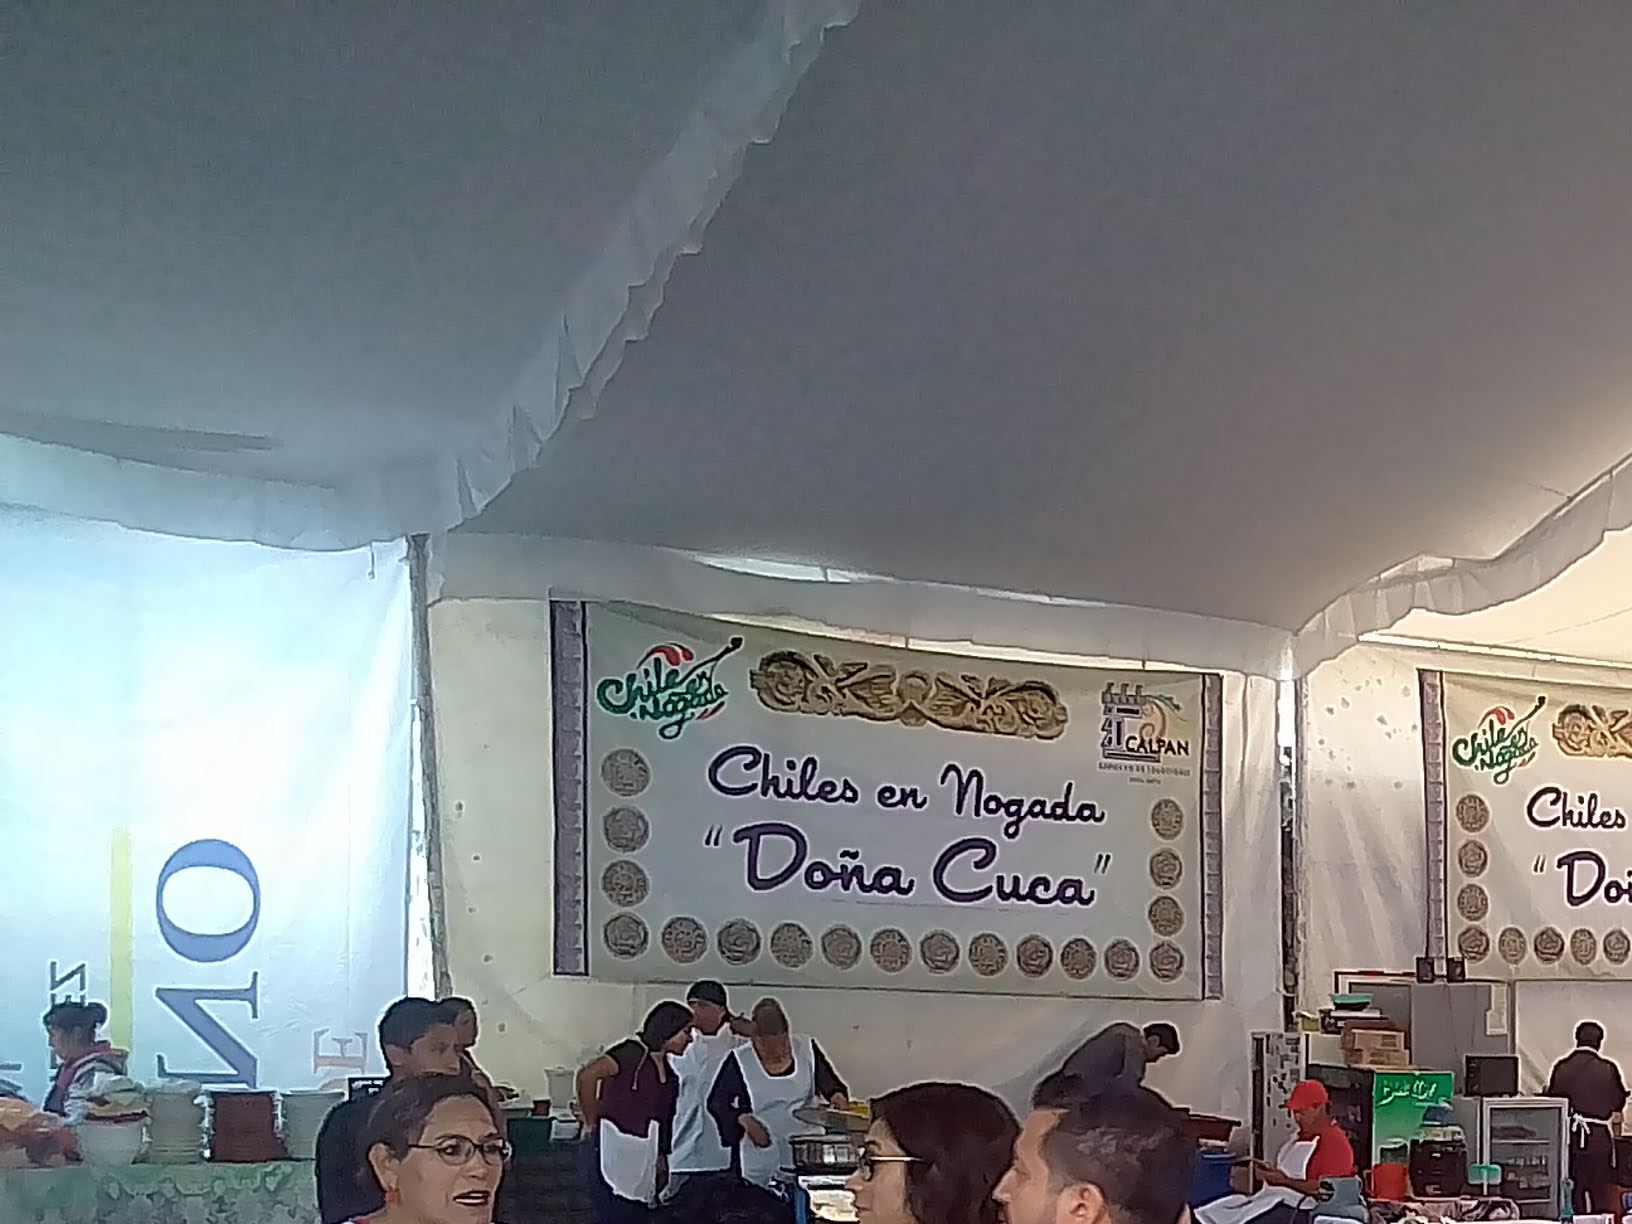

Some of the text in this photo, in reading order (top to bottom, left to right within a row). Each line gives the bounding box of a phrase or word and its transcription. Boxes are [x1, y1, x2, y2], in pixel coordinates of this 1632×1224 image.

[1125, 736, 1189, 755] CALPAN
[708, 746, 1105, 839] Chiles en Nogada
[1526, 786, 1626, 832] Chiles
